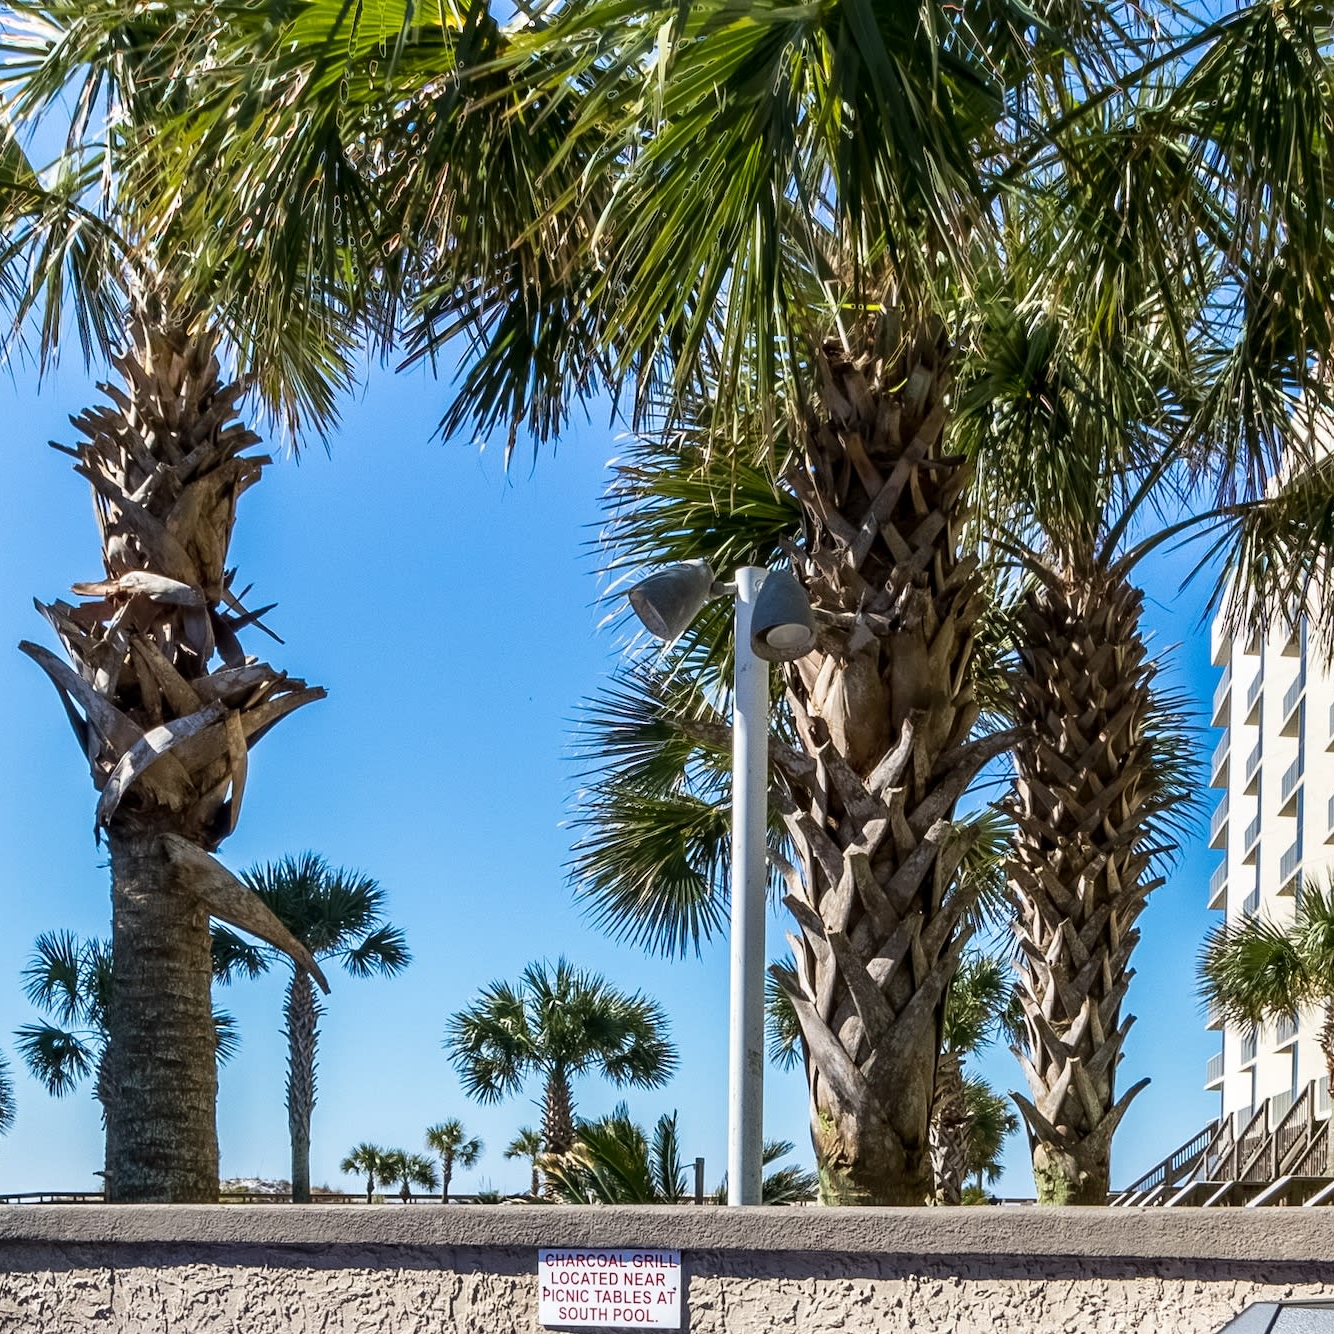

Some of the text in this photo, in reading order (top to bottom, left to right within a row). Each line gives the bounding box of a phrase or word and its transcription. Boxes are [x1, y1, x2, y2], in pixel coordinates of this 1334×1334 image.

[545, 1253, 677, 1268] CHARCOAL GRILL
[551, 1271, 665, 1286] LOCATED NEAR
[543, 1288, 676, 1305] PICNIC TABLES AT
[559, 1307, 658, 1323] SOUTH POOL.
